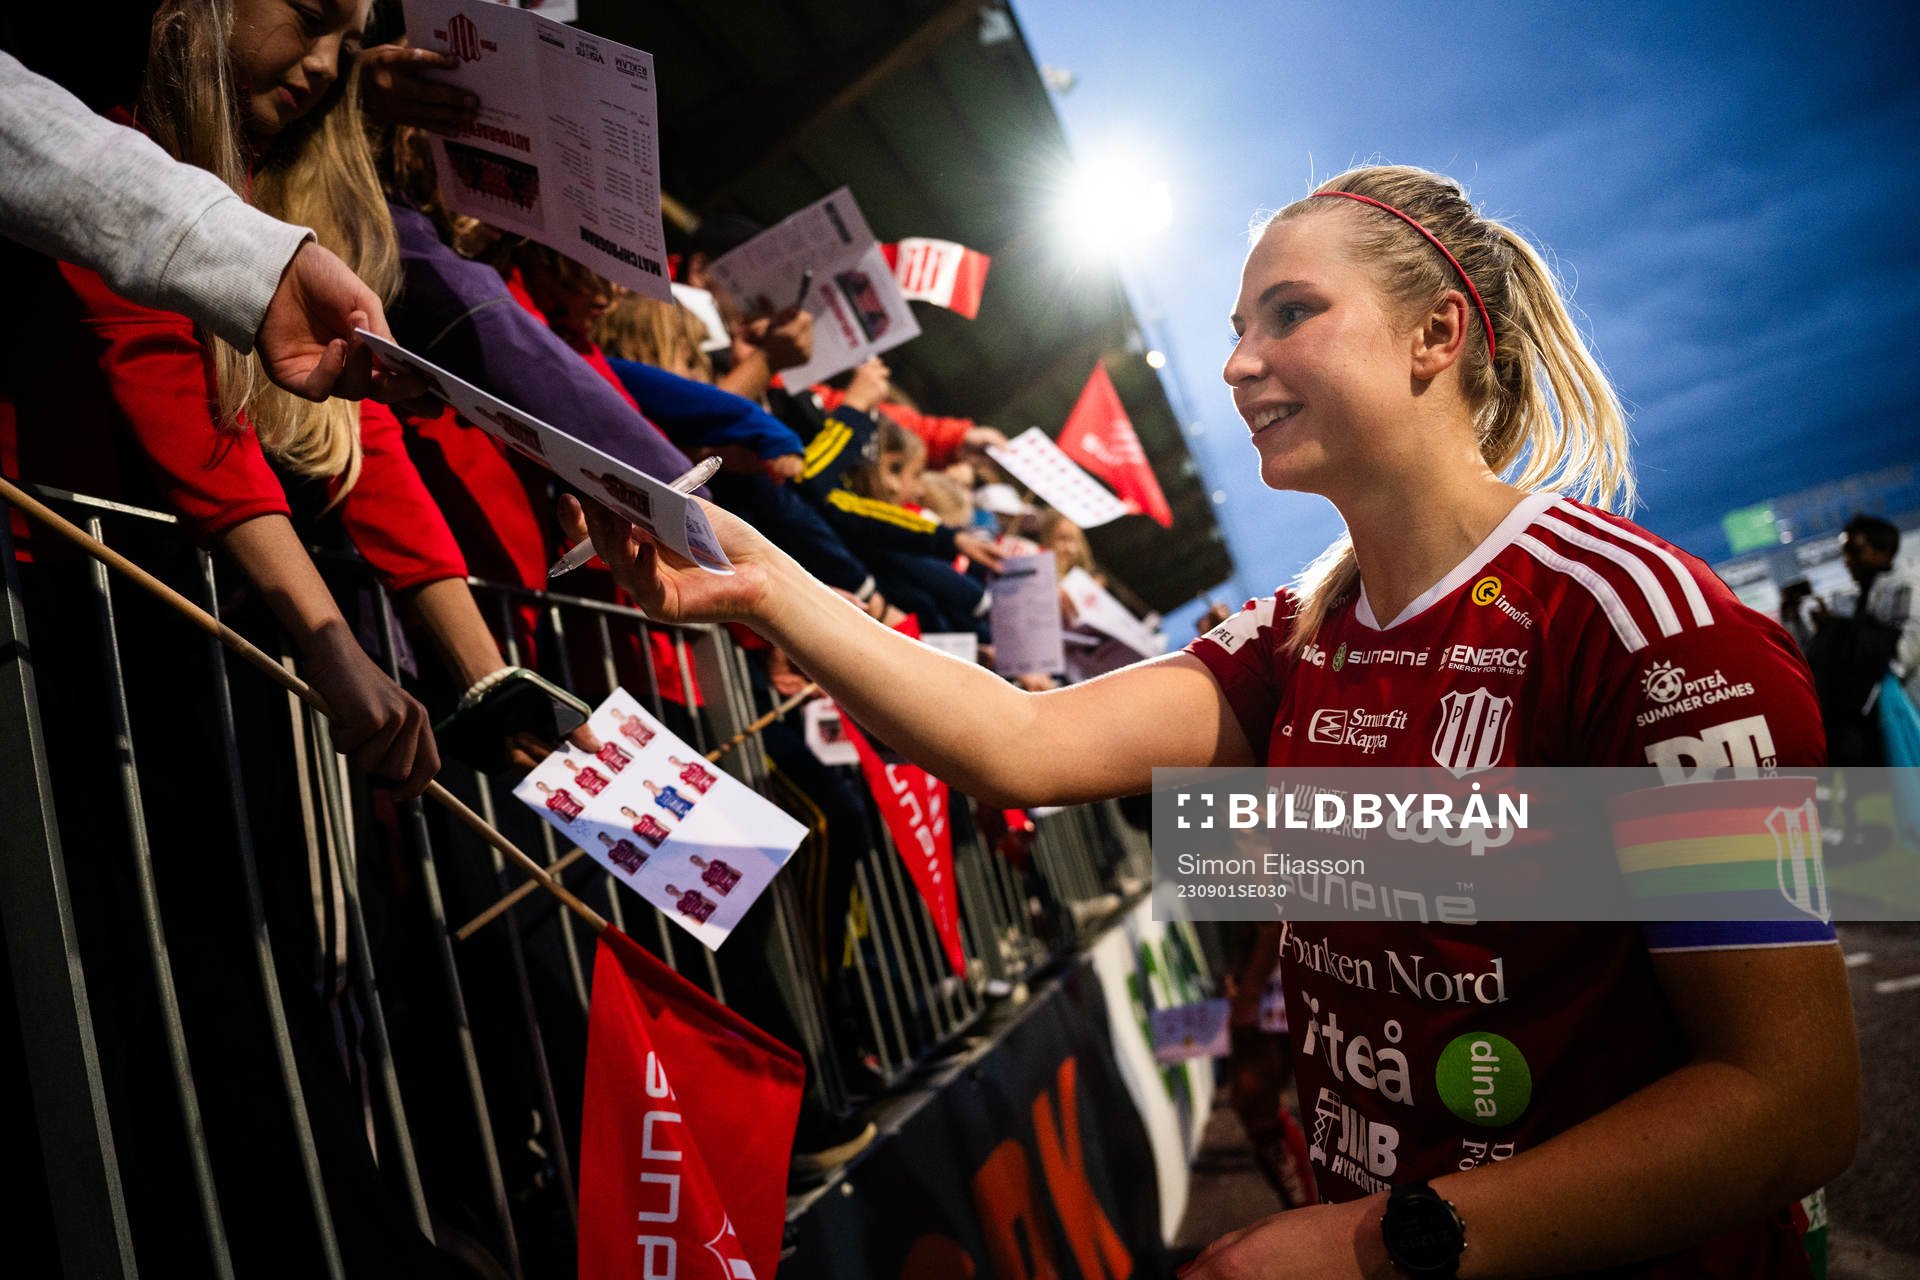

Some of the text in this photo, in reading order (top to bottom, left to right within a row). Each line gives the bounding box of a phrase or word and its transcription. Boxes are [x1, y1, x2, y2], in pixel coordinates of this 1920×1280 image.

[1499, 666, 1515, 676] THE
[1683, 669, 1728, 695] PITEÅ
[1349, 708, 1408, 730] Smurfit
[1636, 682, 1755, 728] SUMMER GAMES
[1343, 726, 1388, 754] Kappa
[1384, 950, 1510, 1005] Nord
[1470, 1040, 1500, 1118] dina
